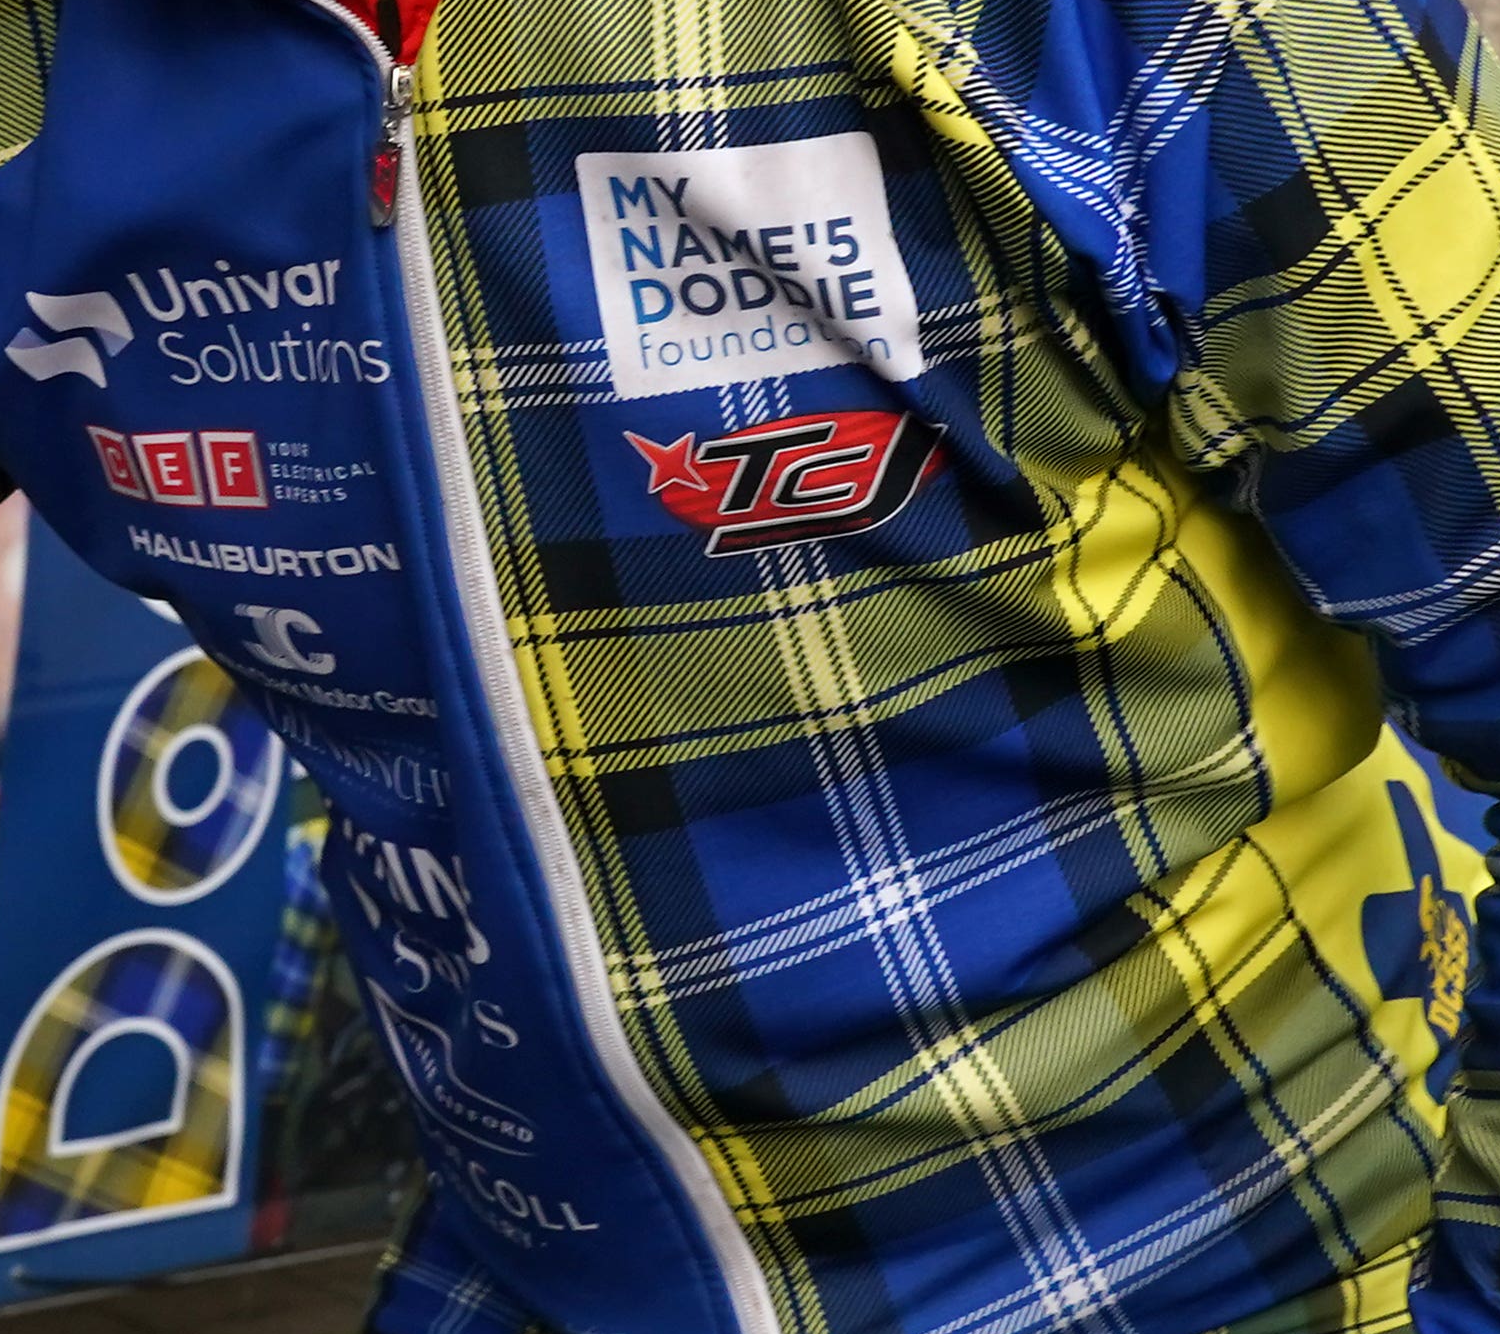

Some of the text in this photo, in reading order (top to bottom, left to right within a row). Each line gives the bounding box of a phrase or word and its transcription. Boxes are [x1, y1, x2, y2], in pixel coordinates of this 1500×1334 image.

[608, 175, 691, 221] MY
[125, 257, 342, 323] Univar
[628, 268, 883, 326] DODDIE
[637, 313, 892, 371] foundaon
[126, 523, 402, 579] HALLIBURTON
